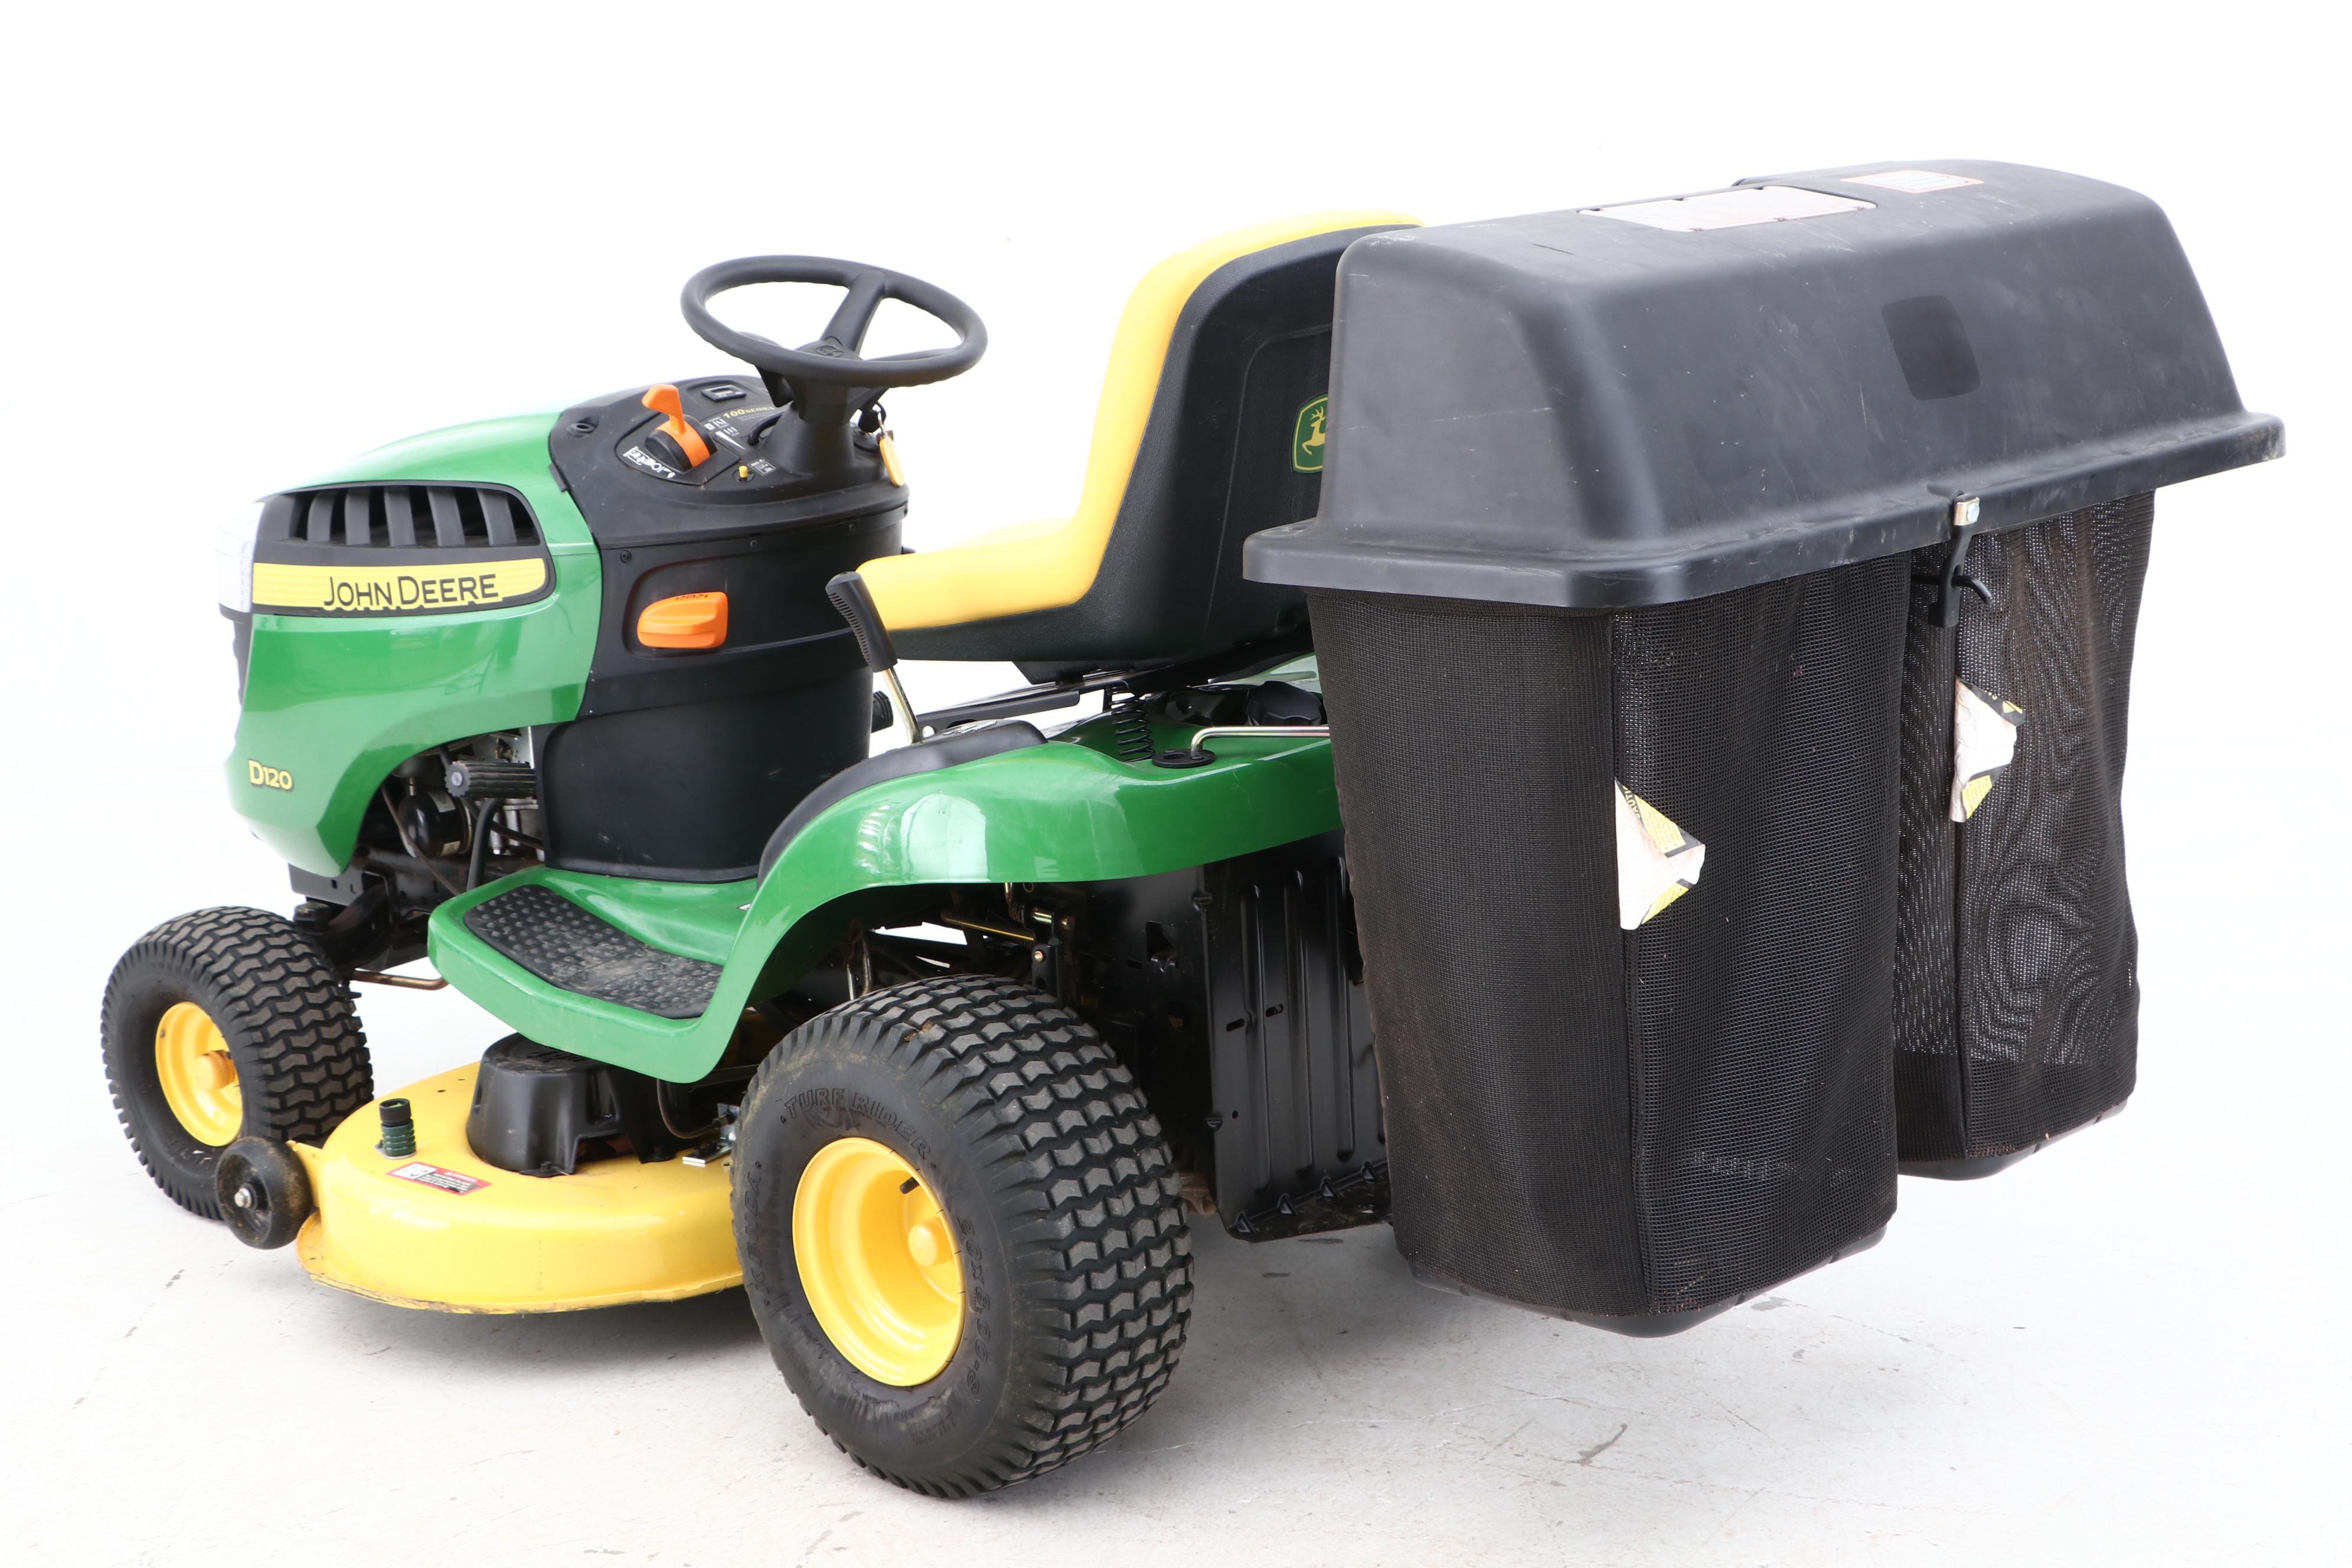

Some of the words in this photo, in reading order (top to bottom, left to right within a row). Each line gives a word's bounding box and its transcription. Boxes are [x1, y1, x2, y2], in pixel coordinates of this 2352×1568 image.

[324, 576, 393, 606] JOHN
[397, 573, 499, 605] DEERE
[248, 759, 293, 790] D120
[784, 1088, 845, 1119] TURF
[852, 1092, 931, 1161] RIDER
